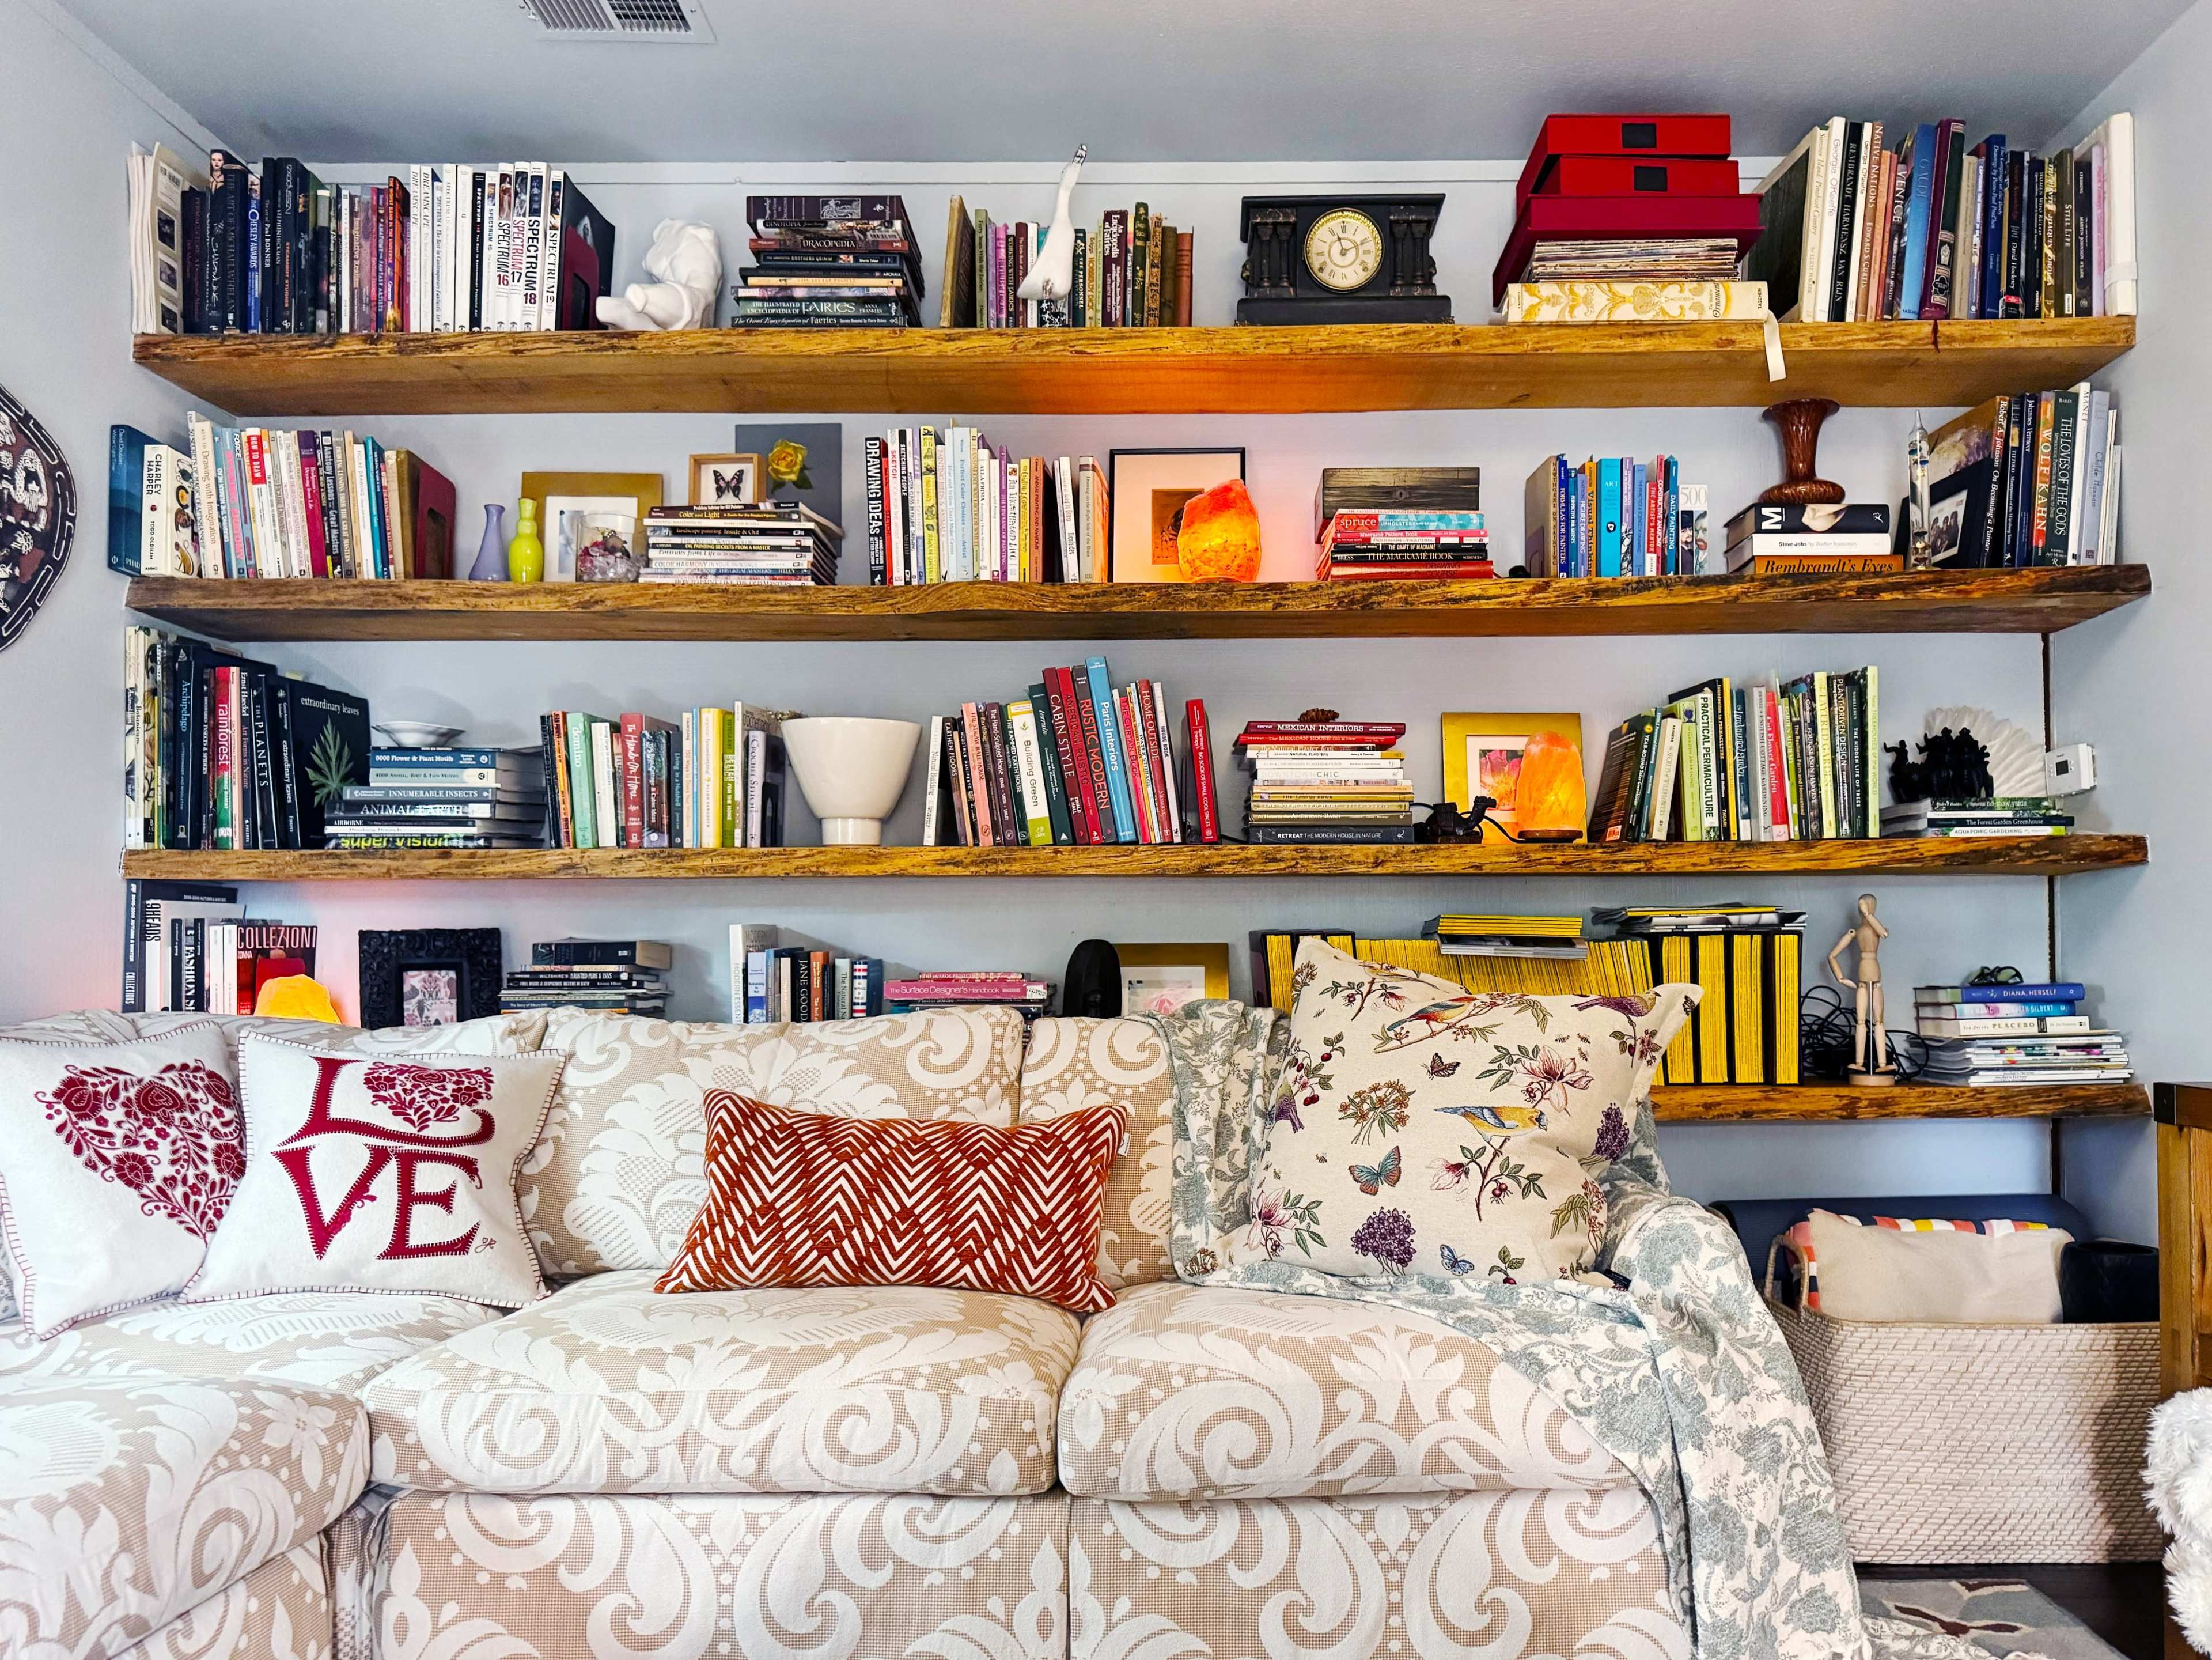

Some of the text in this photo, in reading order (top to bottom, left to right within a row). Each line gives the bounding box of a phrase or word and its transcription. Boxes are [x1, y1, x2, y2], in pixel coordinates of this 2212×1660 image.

[1873, 126, 1883, 161] NATIVE
[1869, 165, 1880, 207] NATIONS
[1893, 171, 1907, 222] VENICE
[249, 209, 259, 241] CHESLEY
[1835, 143, 1857, 302] REMBRANDT HARMENSZ VAN RIJN
[1865, 222, 1873, 252] EDWARD
[497, 222, 510, 285] SPECTRUM 16
[511, 220, 525, 282] SPECTRUM 17
[524, 220, 540, 304] SPECTRUM 18
[547, 232, 558, 293] SPECTRUM
[1997, 426, 2005, 435] A.
[1998, 400, 2008, 425] Robert
[2026, 399, 2035, 426] Johannes
[253, 462, 261, 477] DRAW
[324, 446, 336, 500] Anatomy Lessons
[867, 440, 881, 497] DRAWING
[1993, 470, 2000, 481] On
[1994, 437, 2004, 467] Johnson
[2055, 418, 2073, 535] THE LOVES OF THE GODS
[1987, 484, 1998, 517] Becoming
[2036, 429, 2052, 531] WOLF KAHN
[2091, 451, 2104, 508] Childe Hassam
[331, 528, 339, 554] Masters
[1340, 519, 1377, 527] spruce
[1984, 525, 1993, 553] Painter
[1765, 559, 1893, 573] Rembrandt's Eyes
[180, 680, 190, 732] Archipelago
[1142, 690, 1159, 761] HOME OUTSIDE
[218, 704, 230, 766] rainforest
[255, 721, 268, 786] PLANETS
[573, 727, 582, 767] domino
[945, 723, 957, 776] EARTHEN FLOORS
[992, 720, 1002, 758] Hand-Sculpted
[1050, 694, 1075, 778] CABIN STYLE
[1065, 694, 1089, 785] AMERICAN RUSTIC
[1080, 699, 1109, 809] RUSTIC MODERN
[1101, 702, 1119, 771] Paris Interiors
[1122, 700, 1138, 778] THE CURTAIN BOOK
[1701, 697, 1713, 818] PRACTICAL PERMACULTURE
[282, 740, 290, 782] extraordinary
[1024, 740, 1039, 807] Building Green
[237, 927, 316, 948] COLLEZIONI
[125, 972, 135, 1004] COLLECTIONS
[185, 946, 195, 996] FASHION
[798, 960, 808, 985] JANE
[930, 986, 968, 995] Designer's
